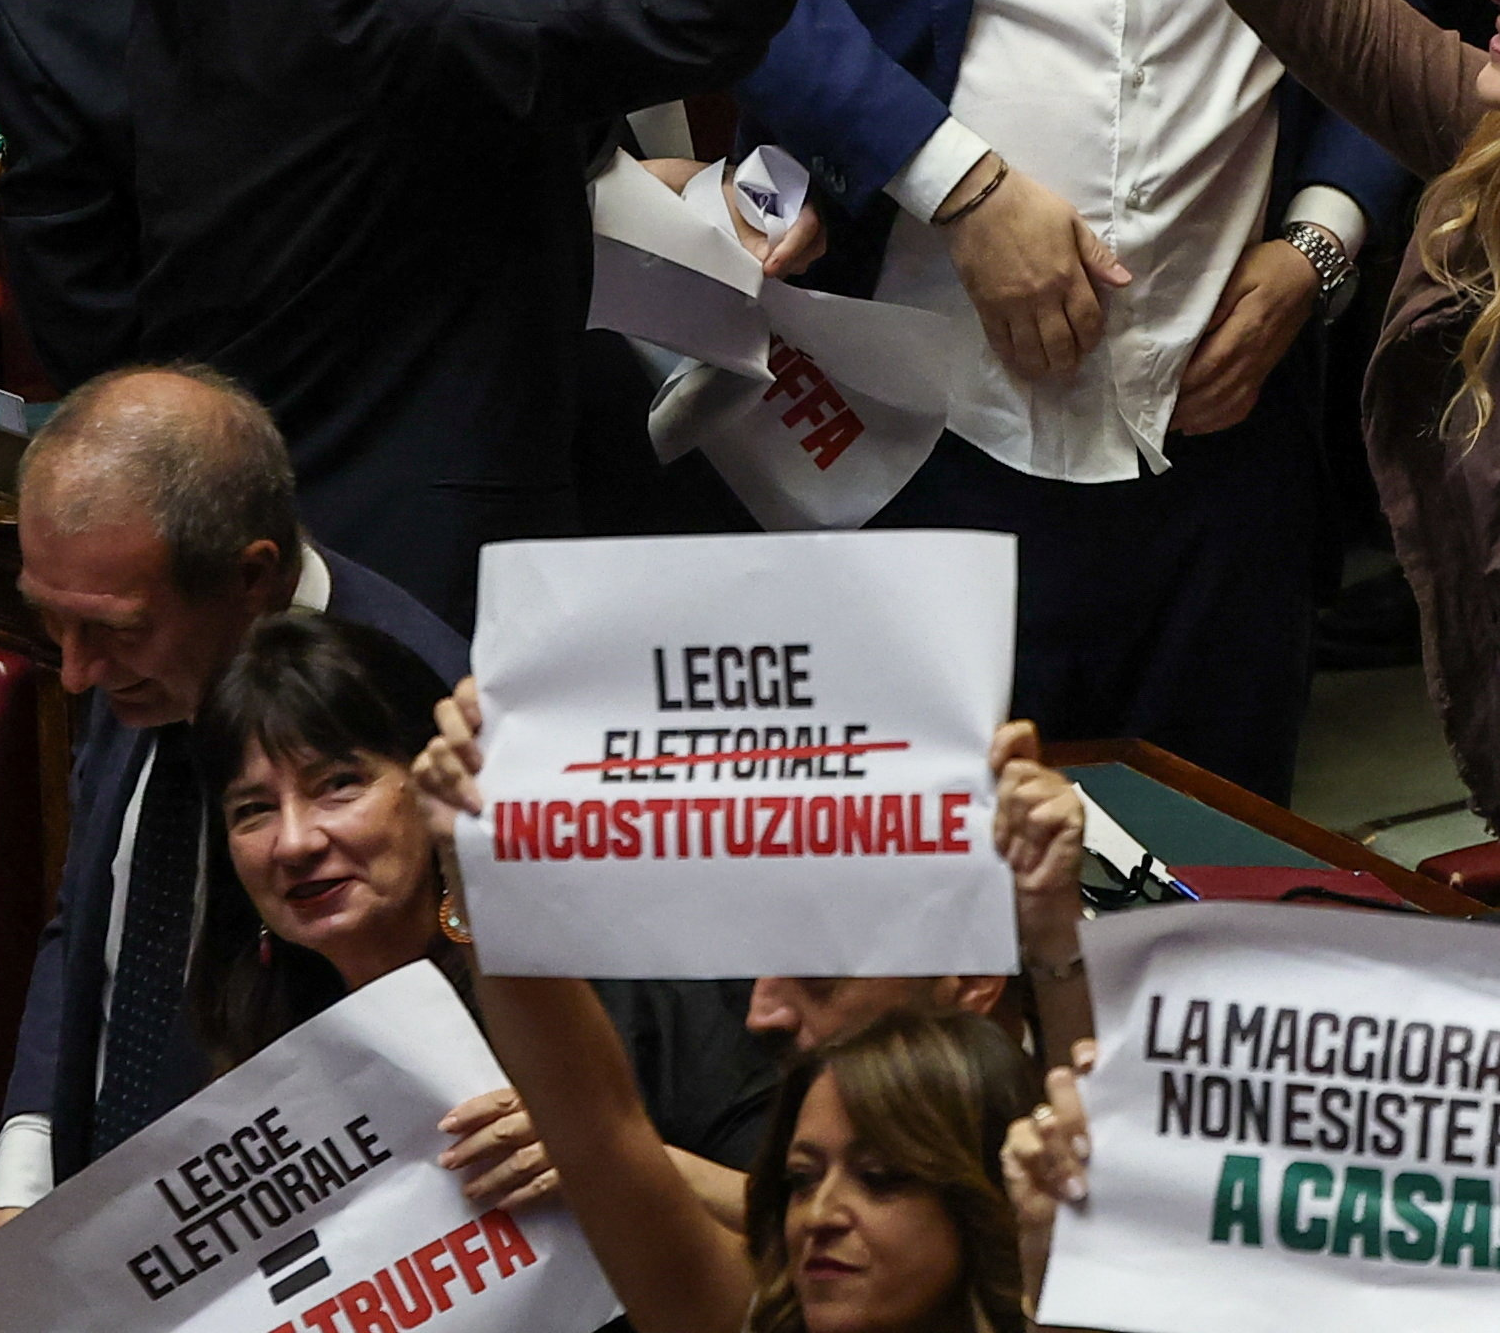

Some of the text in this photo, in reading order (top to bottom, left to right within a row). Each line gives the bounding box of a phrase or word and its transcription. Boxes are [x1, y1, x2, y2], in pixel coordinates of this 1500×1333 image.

[653, 645, 814, 712] LEGGE
[600, 725, 869, 784] ELETTORALE
[493, 793, 971, 863] INCOSTITUZIONALE
[1144, 994, 1211, 1065] LA
[1157, 1070, 1275, 1145] NON
[1284, 1082, 1477, 1166] ESISTE
[154, 1106, 302, 1223] LEGGE
[1209, 1154, 1264, 1247] A
[126, 1115, 393, 1301] ELETTORALE
